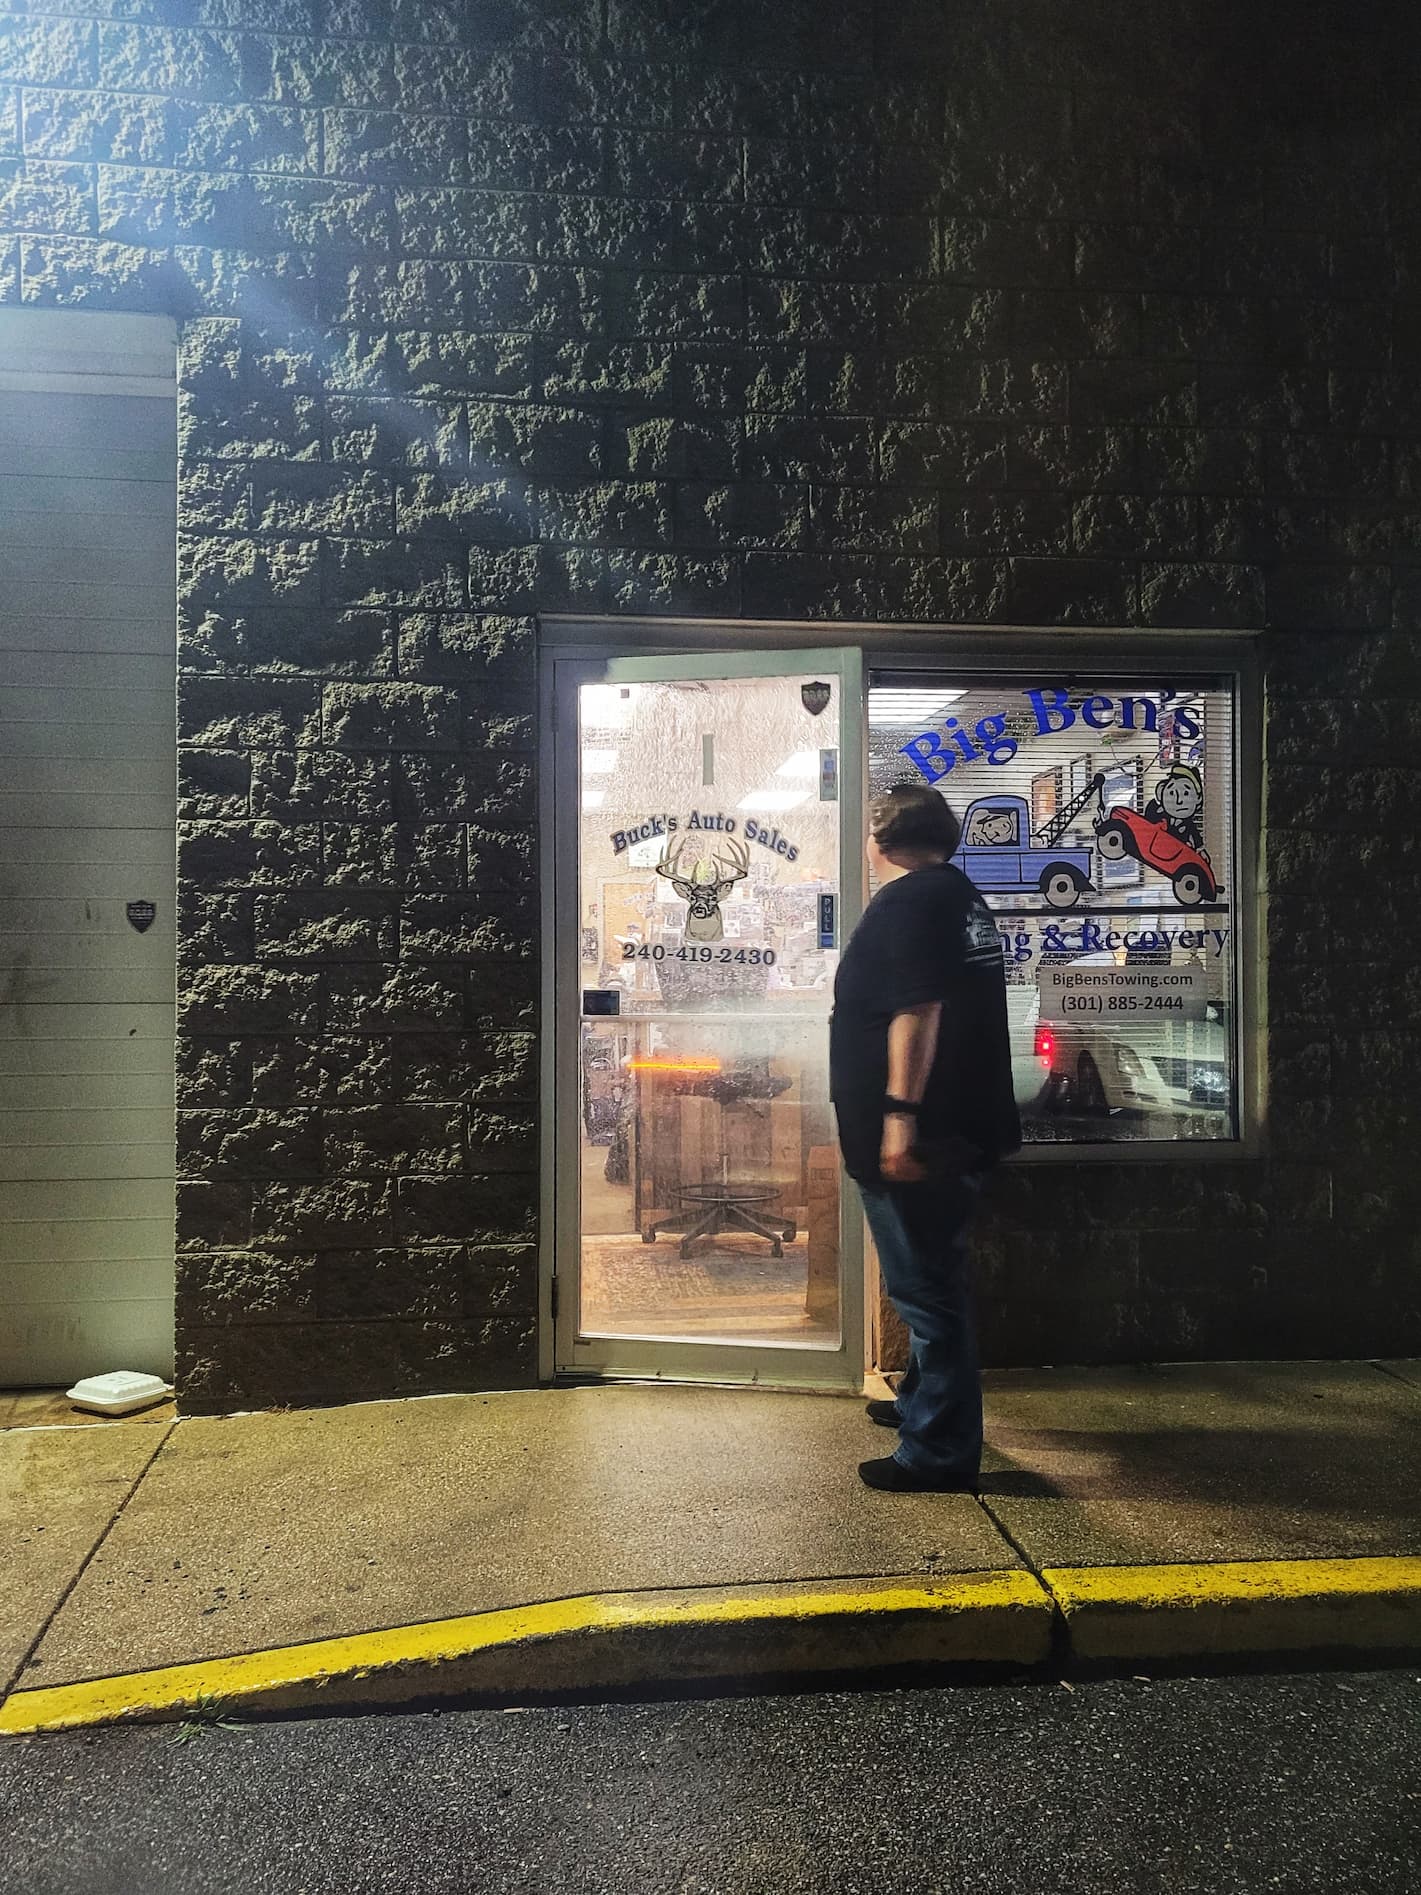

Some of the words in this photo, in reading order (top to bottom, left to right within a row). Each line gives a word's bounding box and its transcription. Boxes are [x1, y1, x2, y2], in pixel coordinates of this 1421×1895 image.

[900, 711, 1018, 785] Big
[1022, 687, 1201, 740] Ben's
[610, 816, 677, 856] Buck's
[687, 810, 735, 833] Auto
[744, 820, 800, 863] Sales
[1042, 924, 1071, 951] &
[1081, 923, 1230, 957] Recovery
[623, 943, 776, 966] 240-419-2430
[1052, 972, 1193, 989] BigBensTowing.com
[1061, 995, 1103, 1014] (301)
[1108, 996, 1184, 1011] 885-2444
